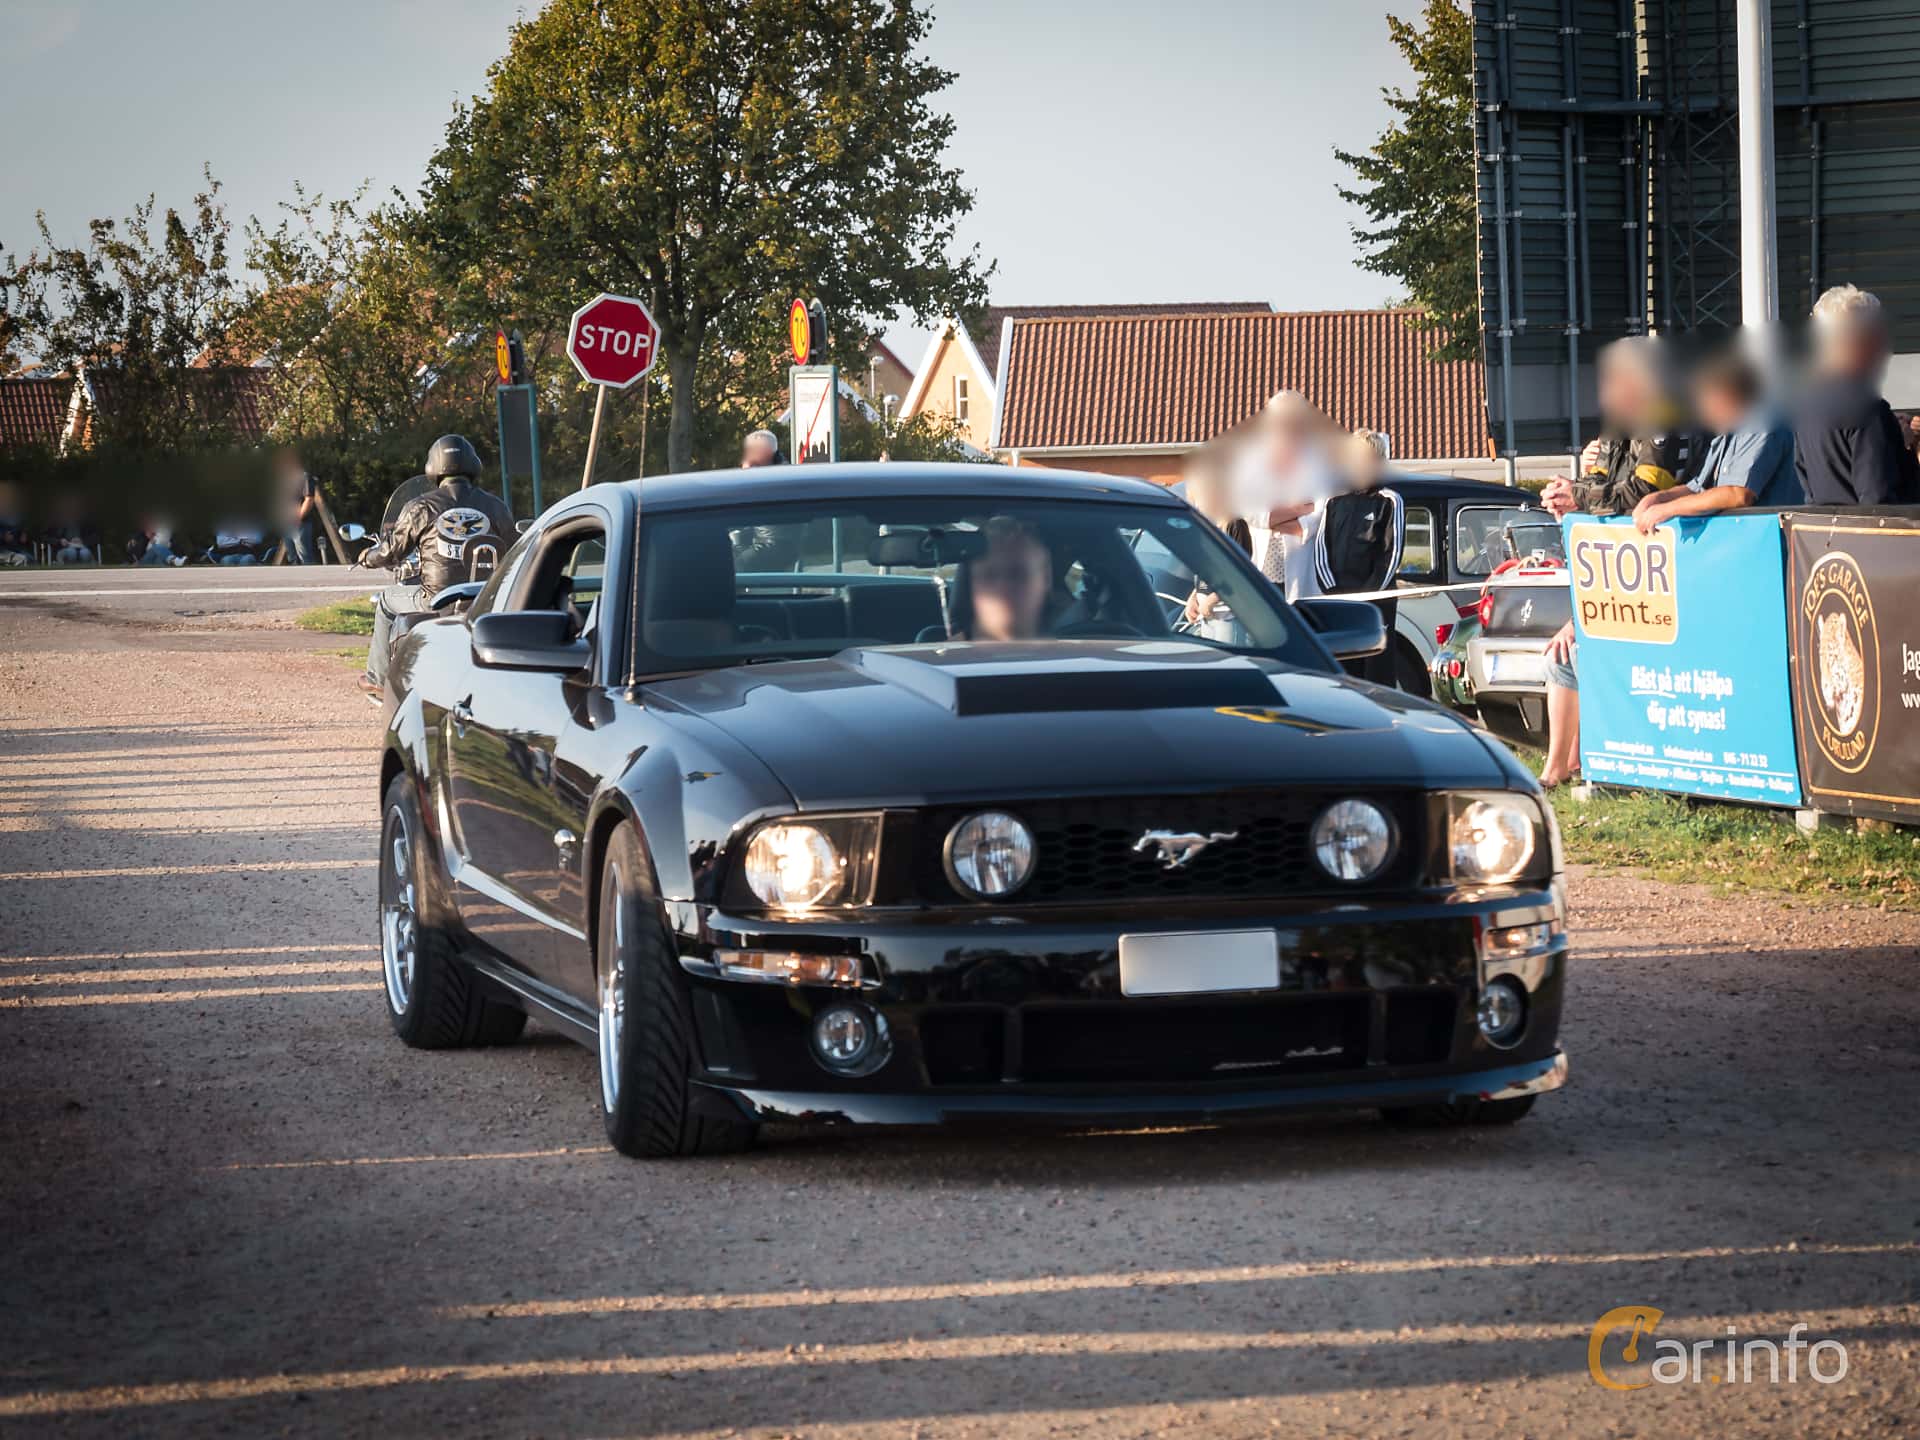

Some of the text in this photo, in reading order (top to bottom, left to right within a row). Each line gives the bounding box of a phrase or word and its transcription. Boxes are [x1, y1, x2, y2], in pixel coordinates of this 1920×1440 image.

[579, 324, 651, 358] STOP
[1576, 541, 1669, 592] STOR
[1582, 596, 1672, 626] print.se
[1828, 562, 1869, 629] GARAGE
[1674, 671, 1692, 694] att
[1667, 704, 1686, 727] att
[1687, 706, 1726, 734] synas!
